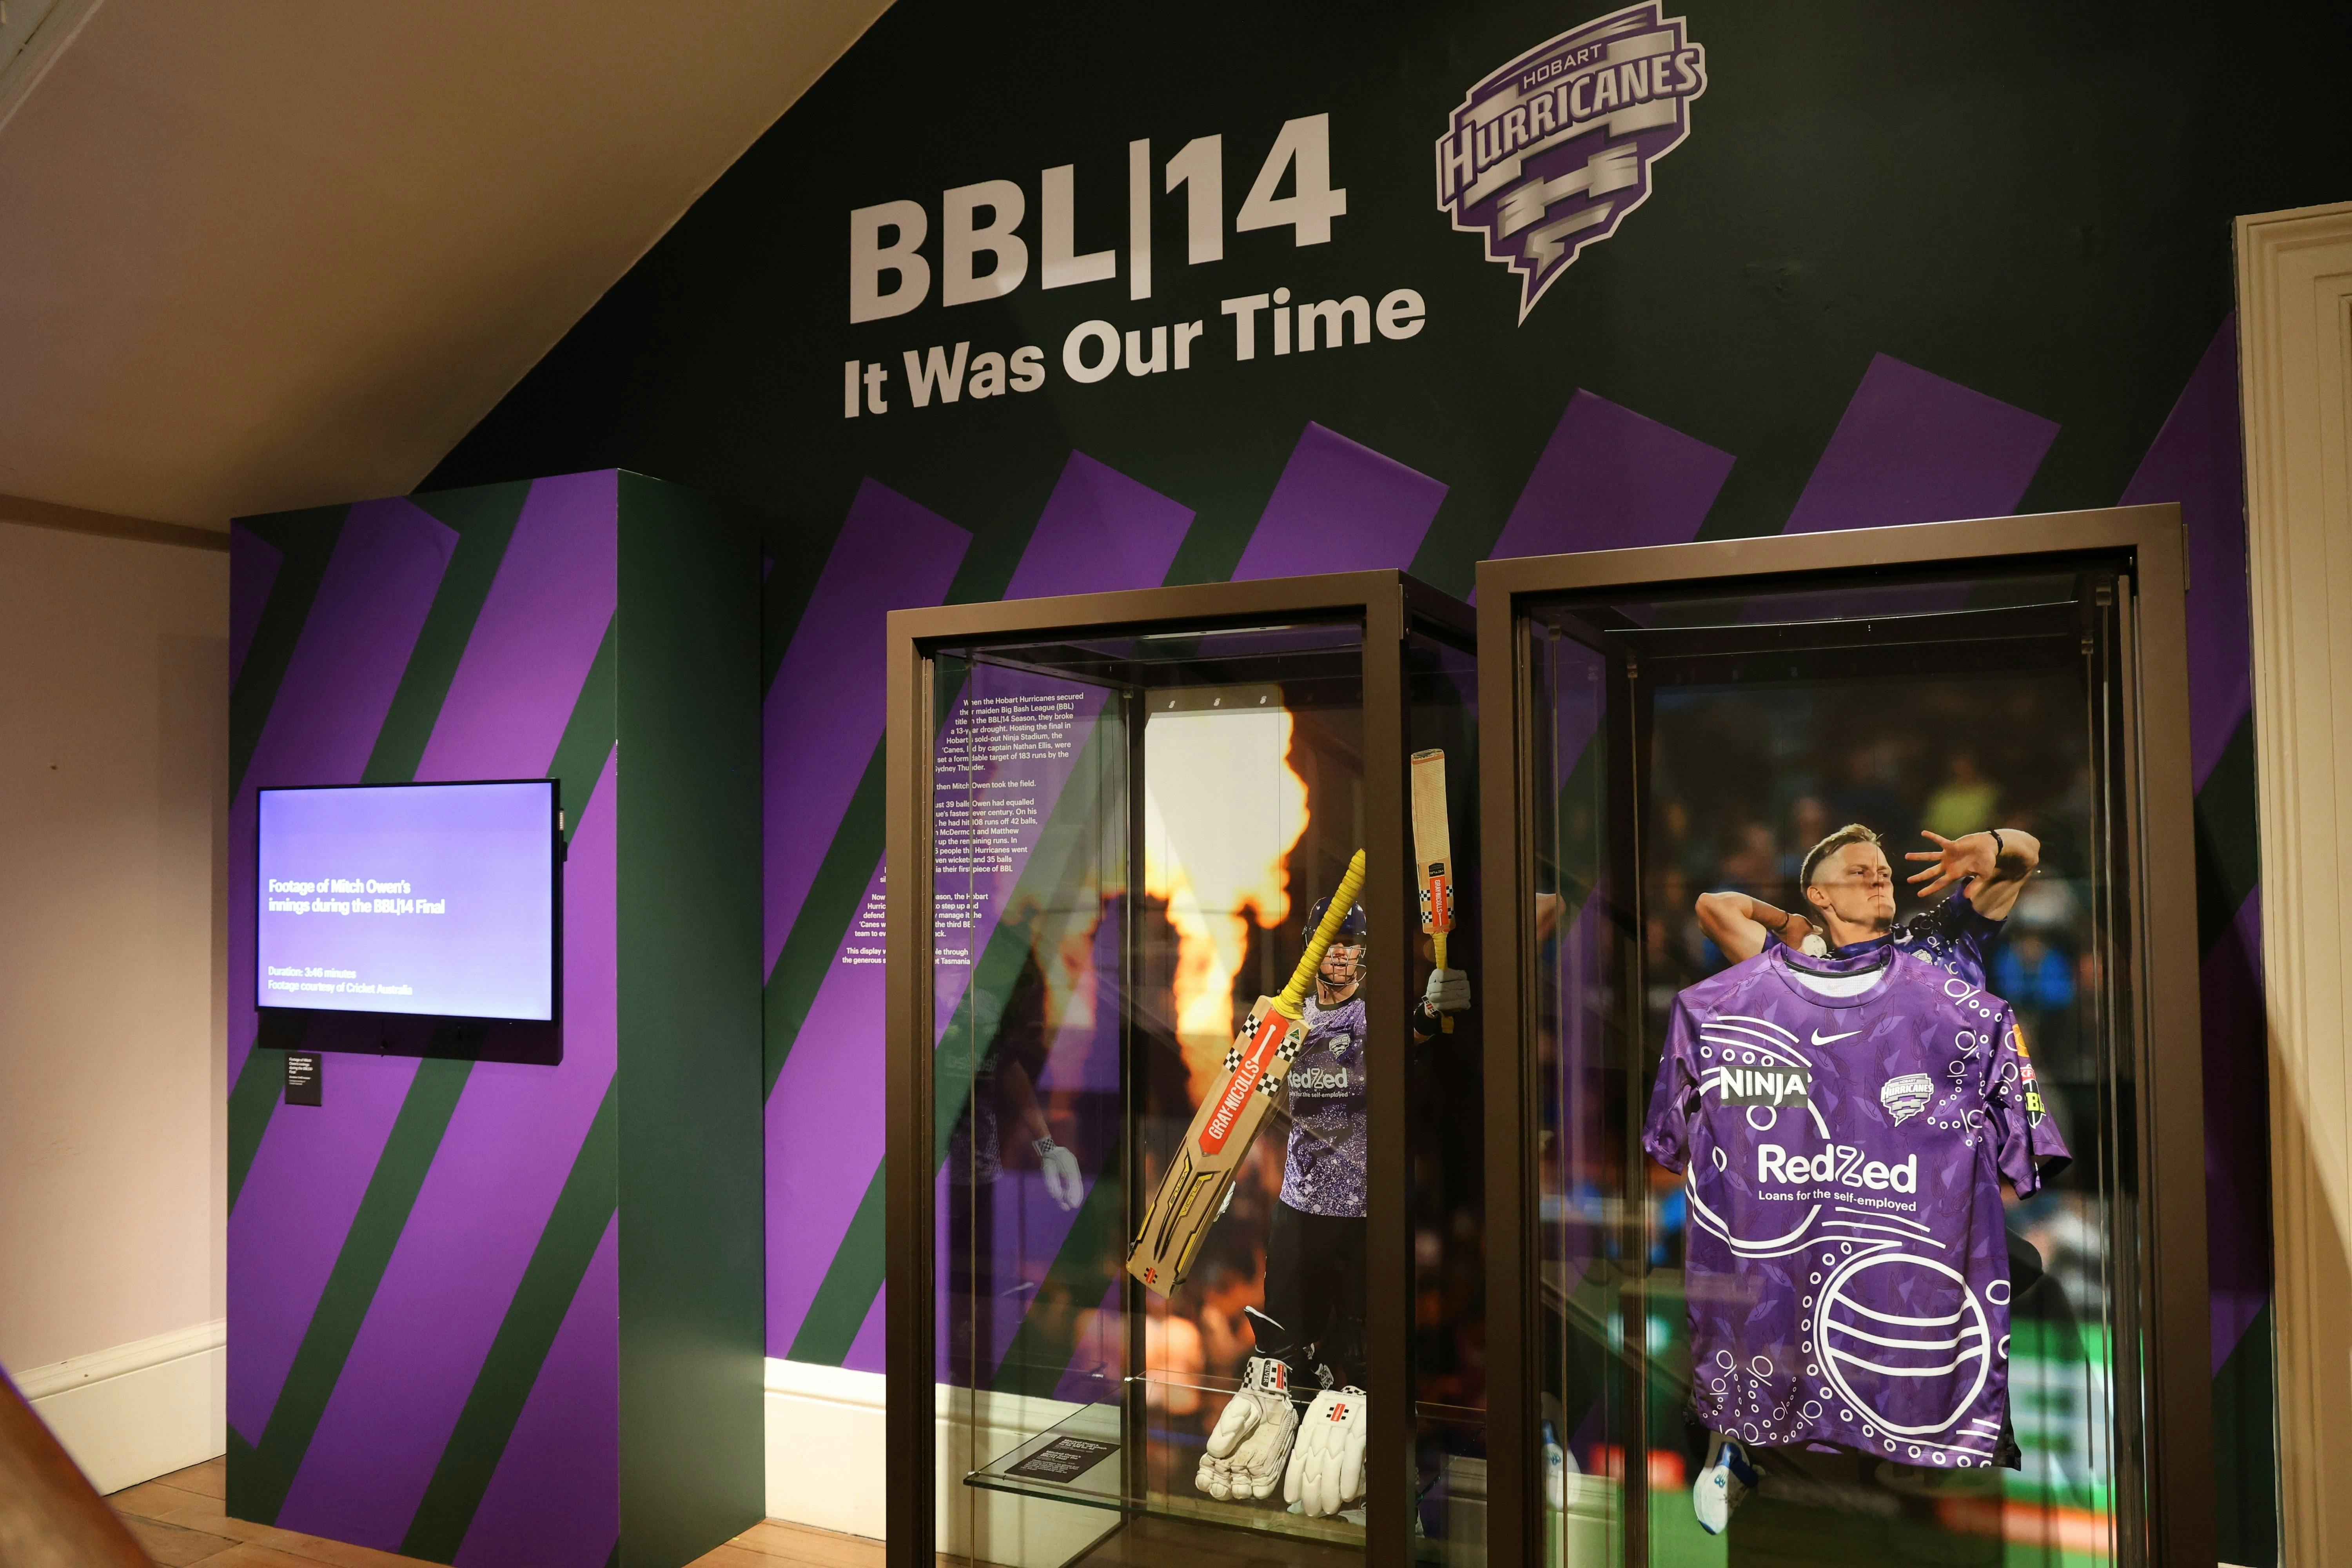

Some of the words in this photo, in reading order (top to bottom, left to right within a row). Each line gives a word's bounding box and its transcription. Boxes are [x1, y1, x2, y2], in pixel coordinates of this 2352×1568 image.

[1523, 44, 1602, 89] HOBART
[1442, 49, 1699, 200] HURRICANES
[850, 113, 1347, 325] BBL|14
[845, 360, 887, 418] It
[904, 341, 1045, 408] Was
[1062, 319, 1203, 384] Our
[1221, 287, 1426, 361] Time
[1057, 702, 1073, 711] (BBL)
[1006, 798, 1034, 806] equalled
[269, 879, 315, 896] Footage
[316, 878, 329, 893] of
[331, 878, 364, 893] Mitch
[1434, 879, 1443, 913] GRAY-NICOLLS
[269, 898, 310, 915] innings
[312, 898, 350, 915] during
[352, 898, 372, 913] the
[416, 899, 445, 914] Final
[268, 966, 303, 976] Duration:
[304, 967, 323, 977] 3:46
[324, 968, 356, 979] minutes
[268, 980, 299, 992] Footage
[300, 982, 335, 993] courtesy
[336, 982, 345, 992] of
[346, 983, 375, 994] Cricket
[377, 984, 412, 995] Australia
[1208, 1059, 1260, 1140] GRAY-NICOLLS
[1720, 1066, 1808, 1107] NINJA
[1757, 1143, 1917, 1194] RedZed
[1182, 1179, 1203, 1212] VICTUS
[1759, 1190, 1794, 1201] Loans
[1796, 1190, 1811, 1200] for
[1813, 1189, 1831, 1200] the
[1833, 1192, 1917, 1212] self-employed
